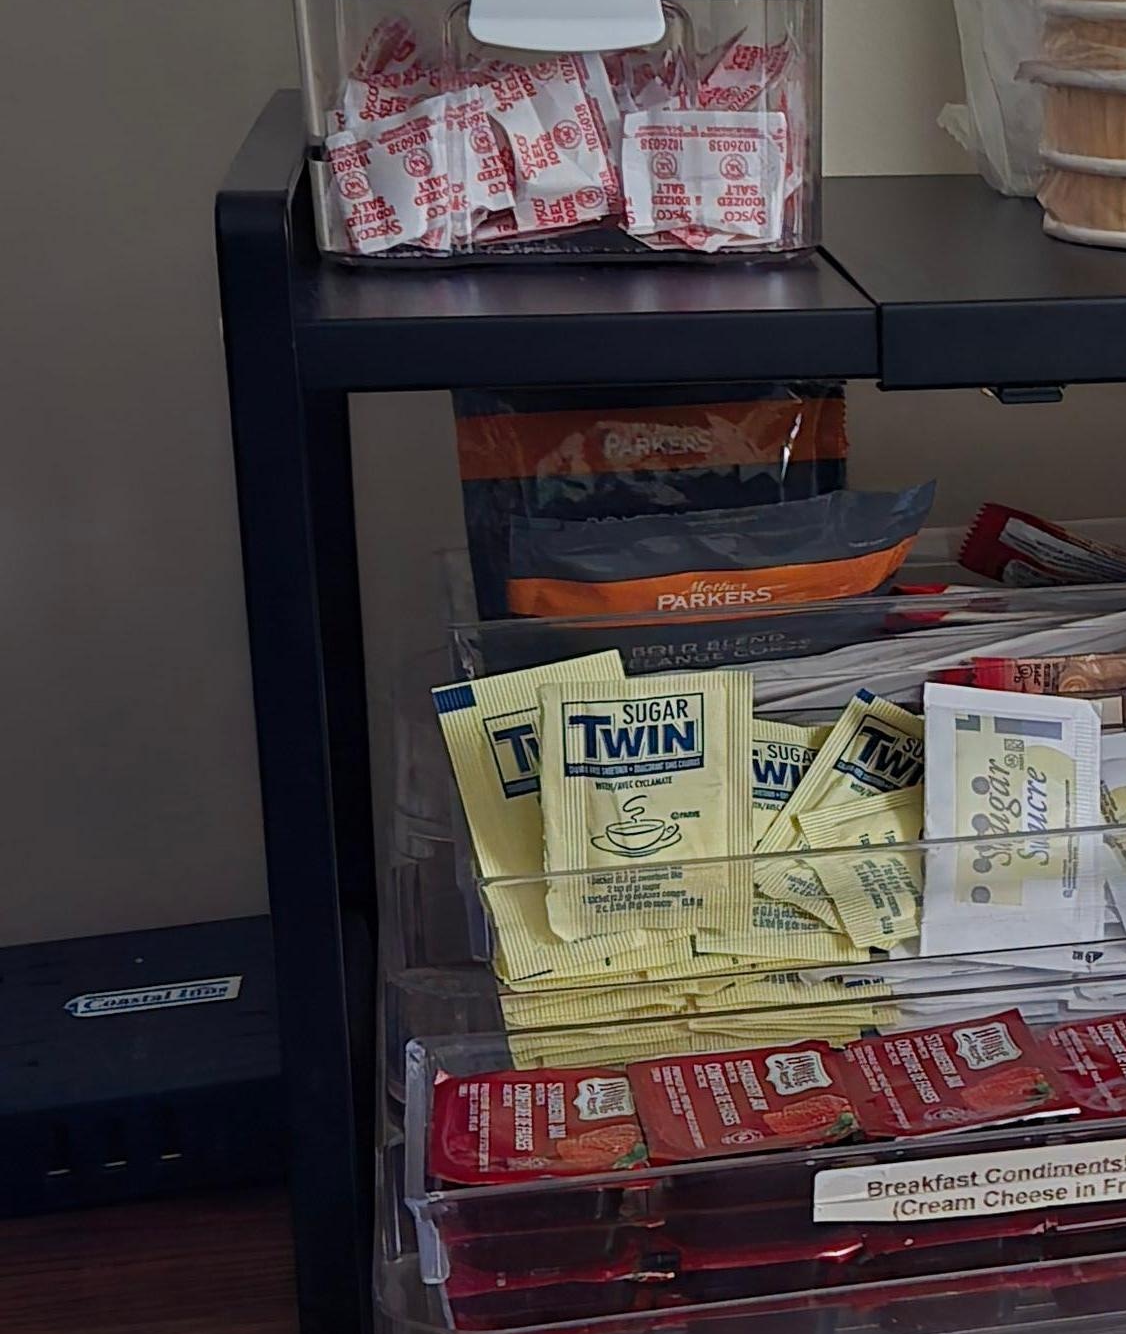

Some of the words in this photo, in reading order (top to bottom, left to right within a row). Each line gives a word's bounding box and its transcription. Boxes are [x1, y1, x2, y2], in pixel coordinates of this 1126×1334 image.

[574, 103, 599, 152] 1026038
[387, 129, 432, 155] 1026038
[531, 138, 548, 169] SEL
[640, 138, 684, 151] 1026038
[708, 139, 757, 152] 1026038
[651, 195, 691, 206] IODIZED
[657, 183, 686, 194] SALT
[724, 184, 759, 196] SALT
[351, 196, 385, 215] SALT
[549, 198, 565, 224] SEL
[717, 196, 766, 207] IODIZED
[604, 430, 712, 457] PARKERS
[657, 586, 772, 611] PARKERS
[623, 699, 688, 725] SUGAR
[83, 991, 171, 1009] Coastal
[867, 1168, 980, 1199] Breakfast
[892, 1192, 977, 1221] (Cream
[983, 1184, 1069, 1210] Cheese
[1075, 1180, 1097, 1199] in
